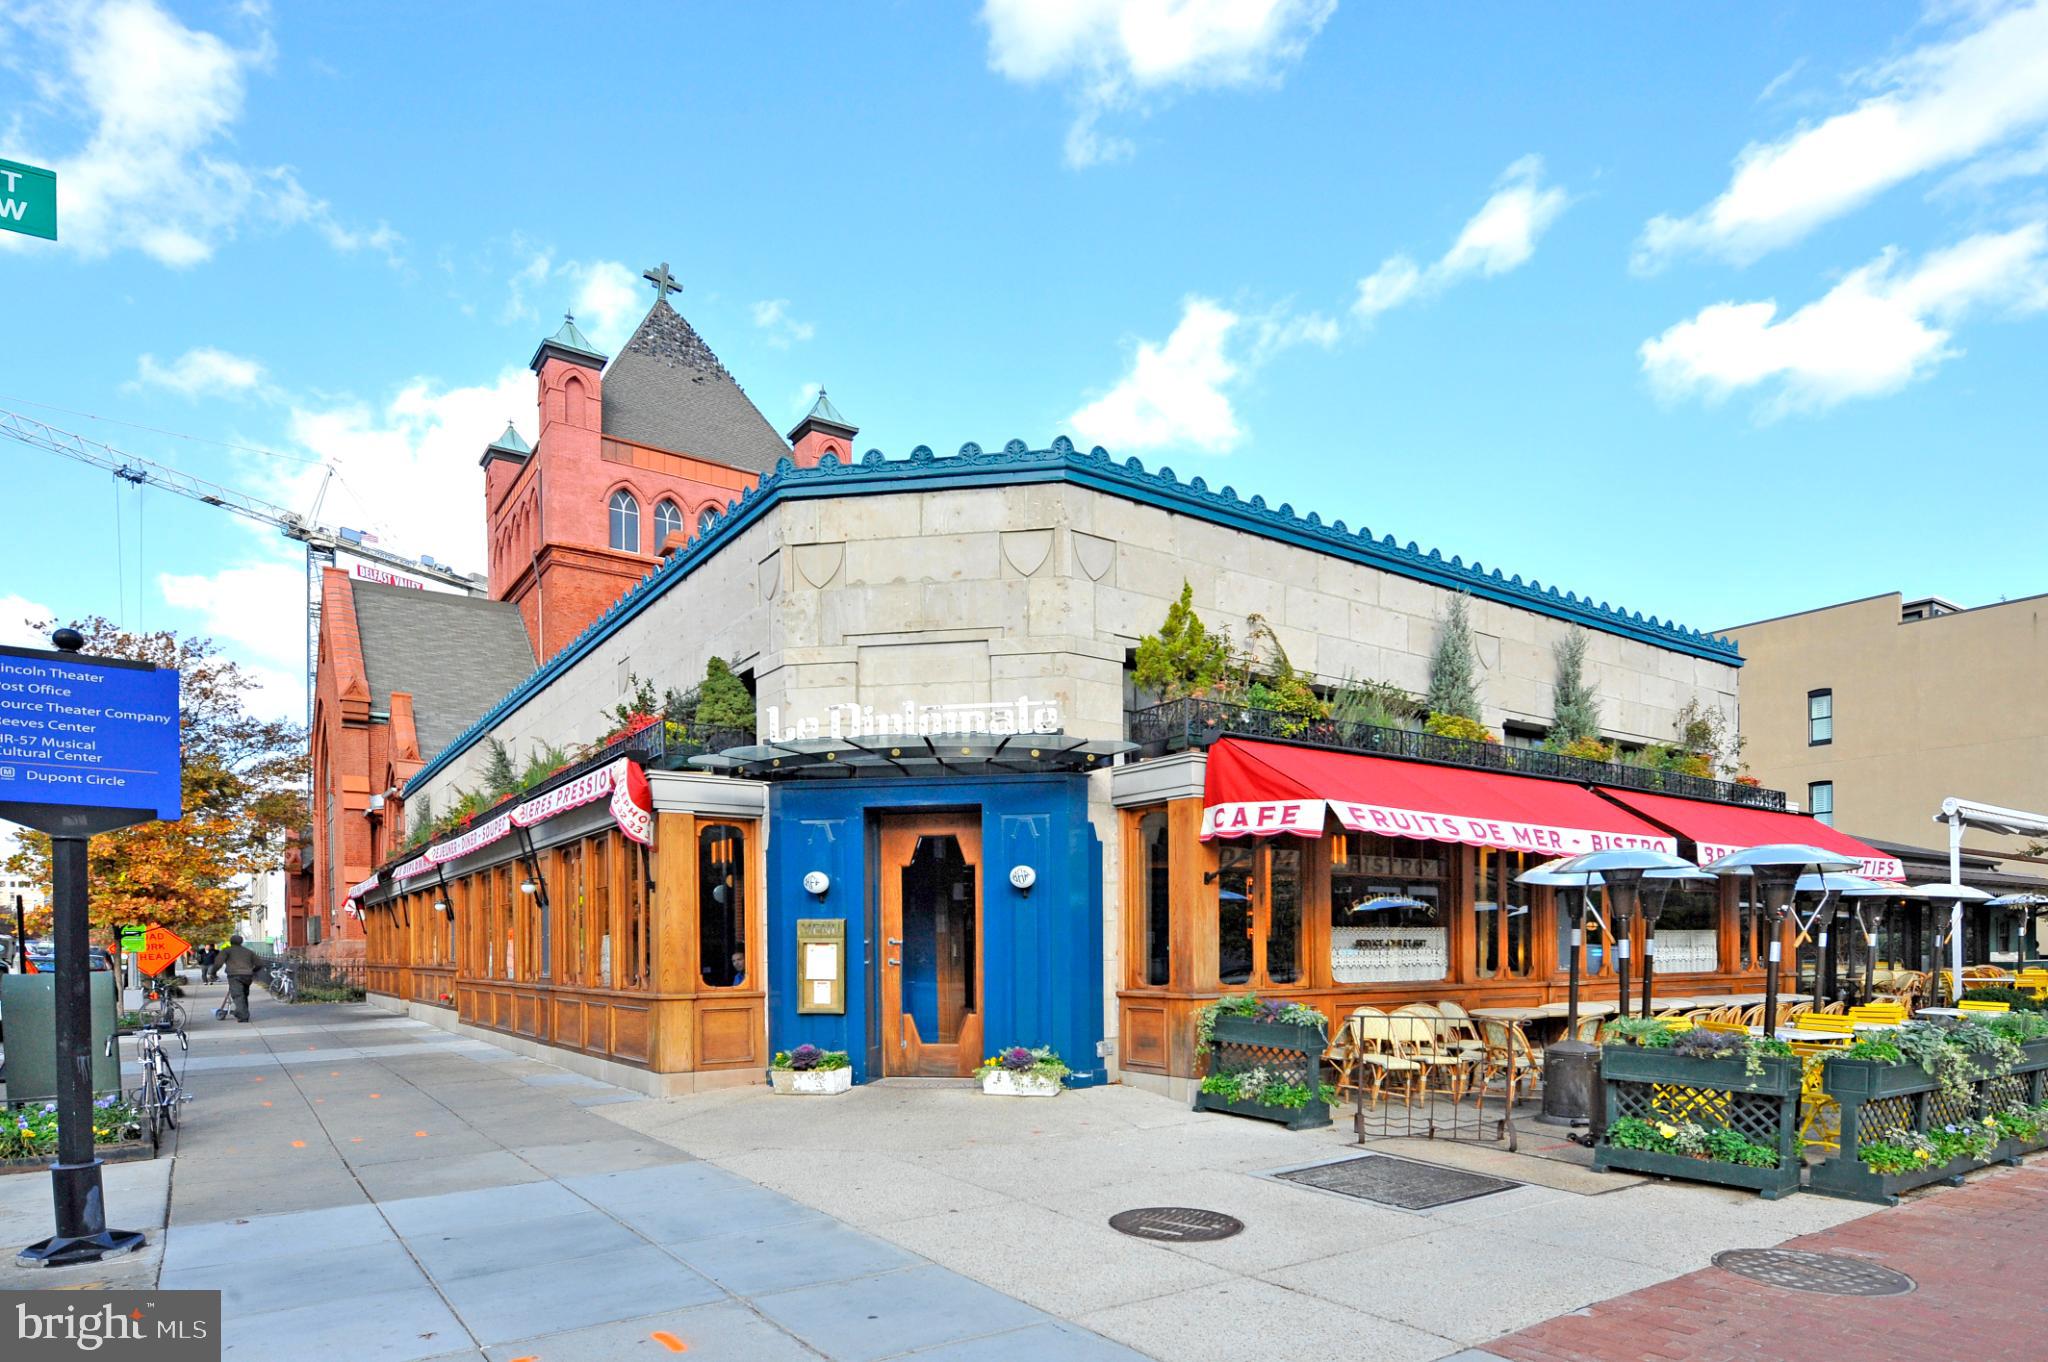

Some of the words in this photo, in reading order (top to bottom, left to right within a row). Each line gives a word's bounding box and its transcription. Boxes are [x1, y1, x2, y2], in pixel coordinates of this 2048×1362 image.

[359, 564, 392, 585] BELFAST
[0, 663, 46, 677] incoln
[49, 667, 104, 683] Theater
[0, 682, 25, 692] ost
[28, 683, 72, 697] Office
[0, 700, 44, 712] ource
[45, 702, 102, 717] Theater
[104, 708, 172, 725] Company
[0, 717, 45, 729] eeves
[48, 720, 96, 733] Center
[766, 706, 820, 743] Le
[41, 737, 96, 751] Musical
[0, 746, 51, 759] ultural
[54, 750, 103, 764] Center
[26, 770, 83, 784] Dupont
[86, 774, 126, 787] Circle
[1213, 804, 1302, 829] CAFE
[1348, 806, 1461, 836] FRUITS
[1469, 821, 1505, 841] DE
[1512, 826, 1563, 849] MER
[1344, 900, 1361, 916] LE
[140, 952, 172, 961] HEAD
